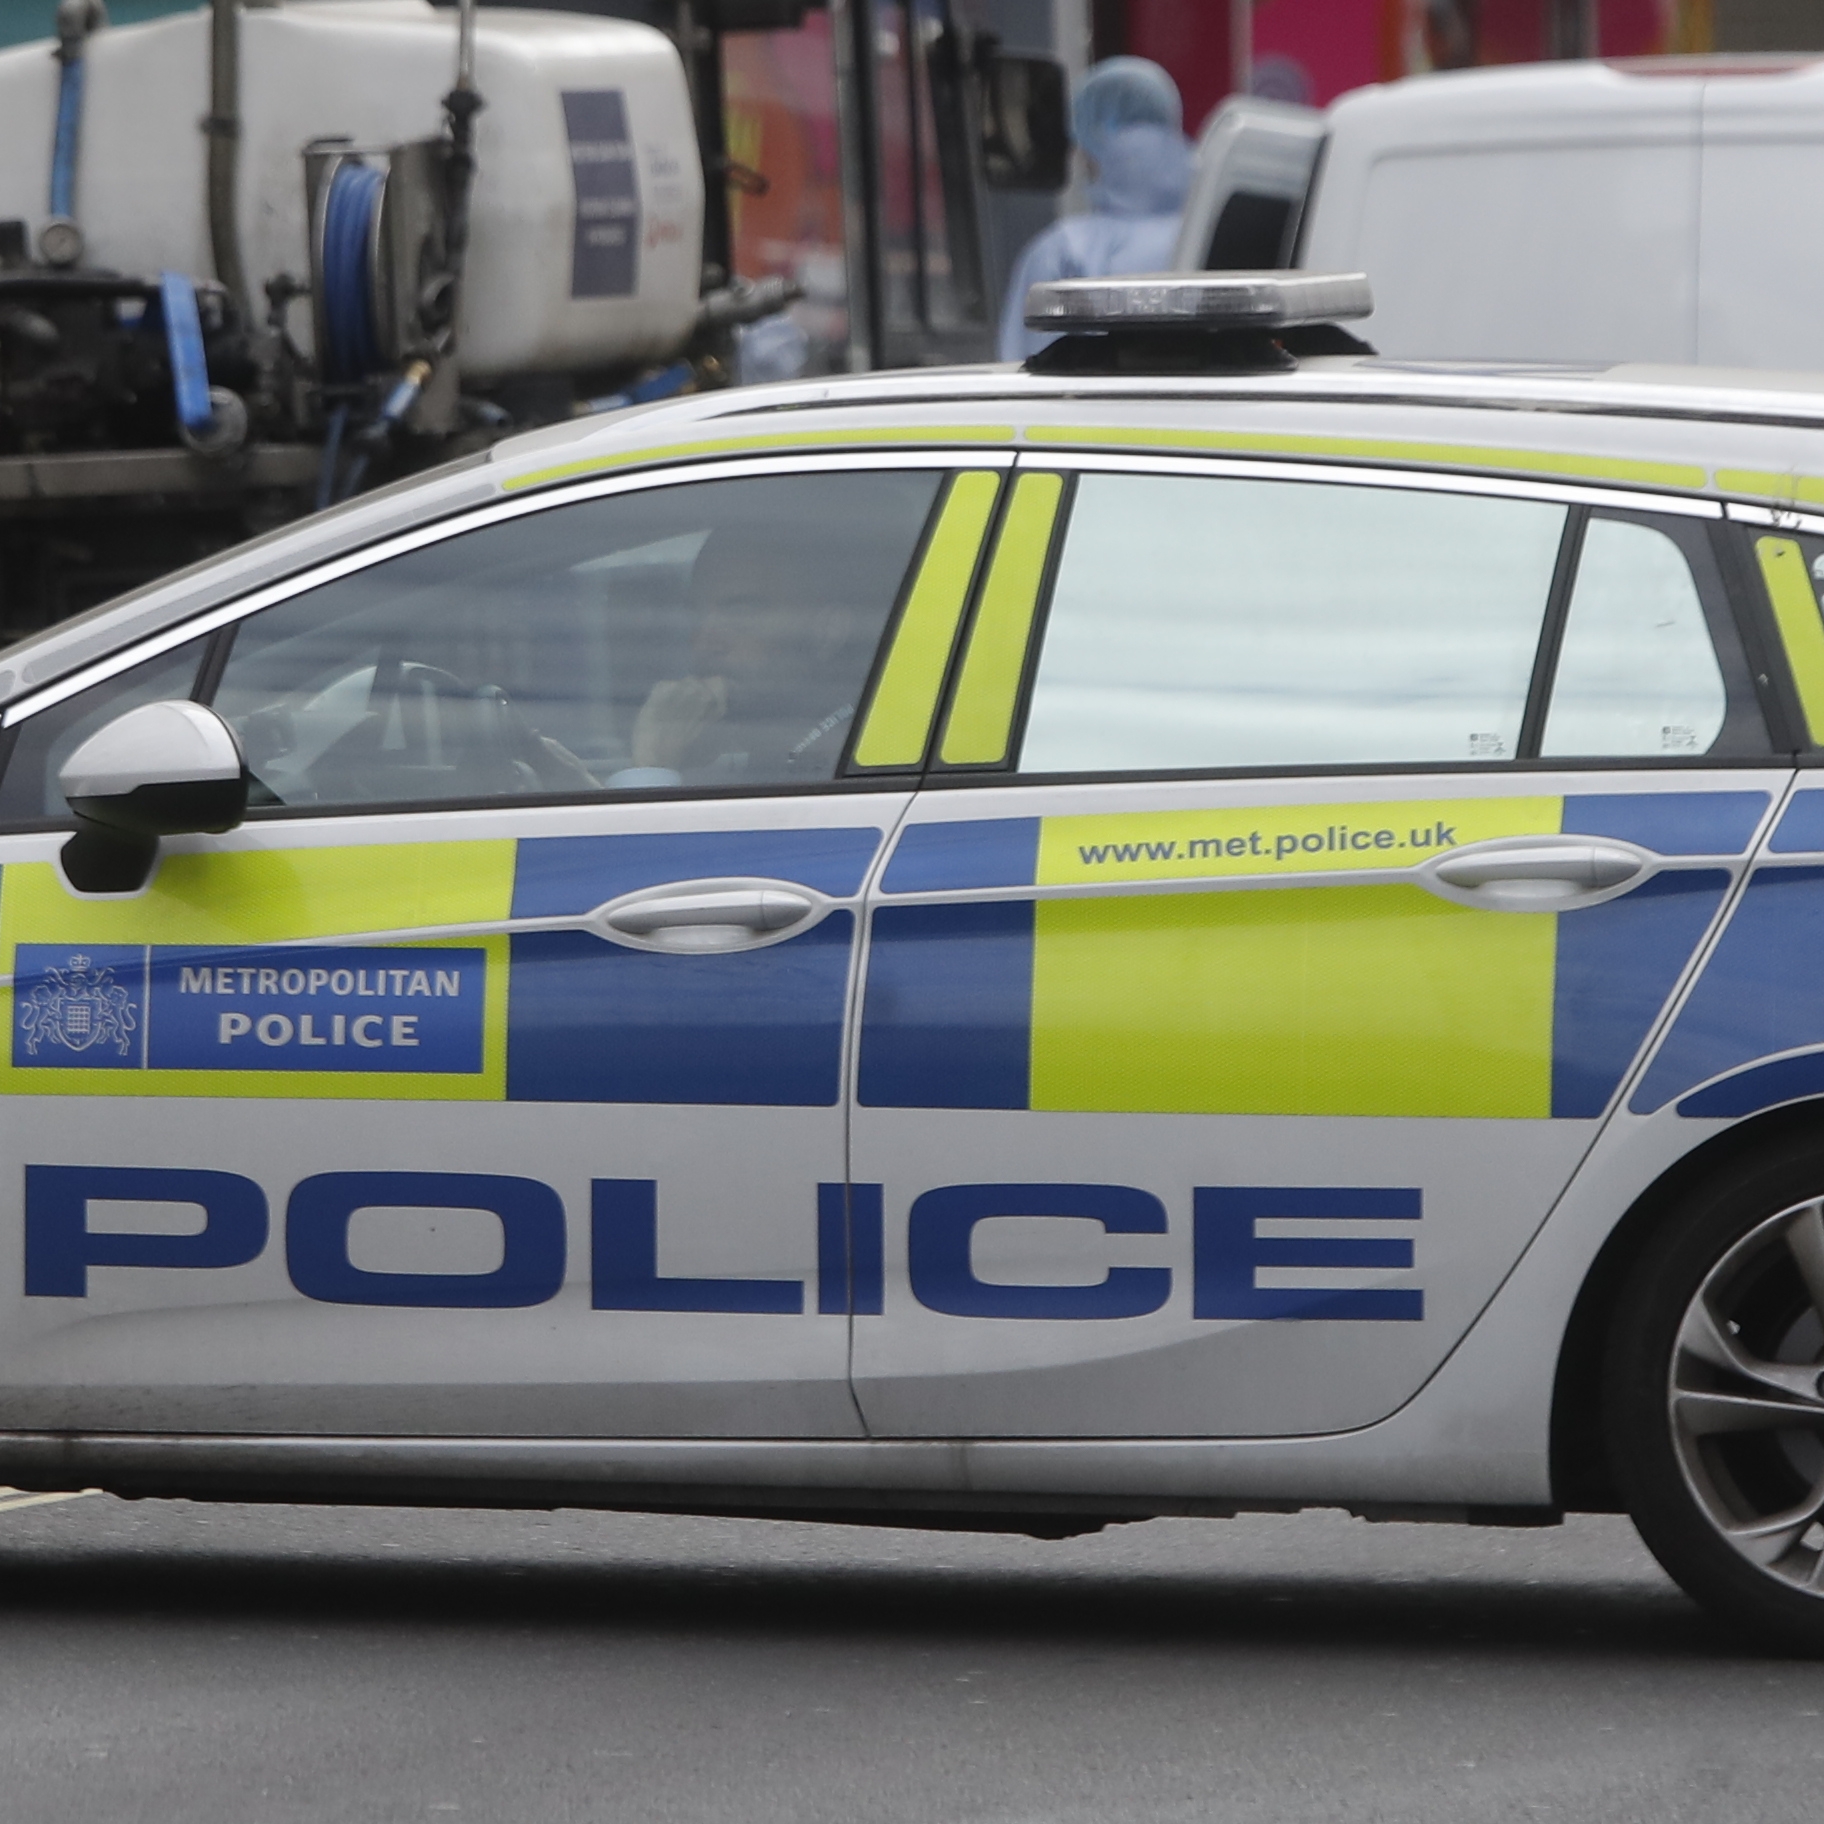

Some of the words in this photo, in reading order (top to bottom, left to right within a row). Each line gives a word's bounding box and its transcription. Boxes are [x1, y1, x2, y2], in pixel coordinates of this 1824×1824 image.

[1079, 821, 1458, 864] www.met.police.uk
[180, 966, 461, 997] METROPOLITAN
[219, 1012, 421, 1048] POLICE
[23, 1164, 1425, 1322] POLICE
